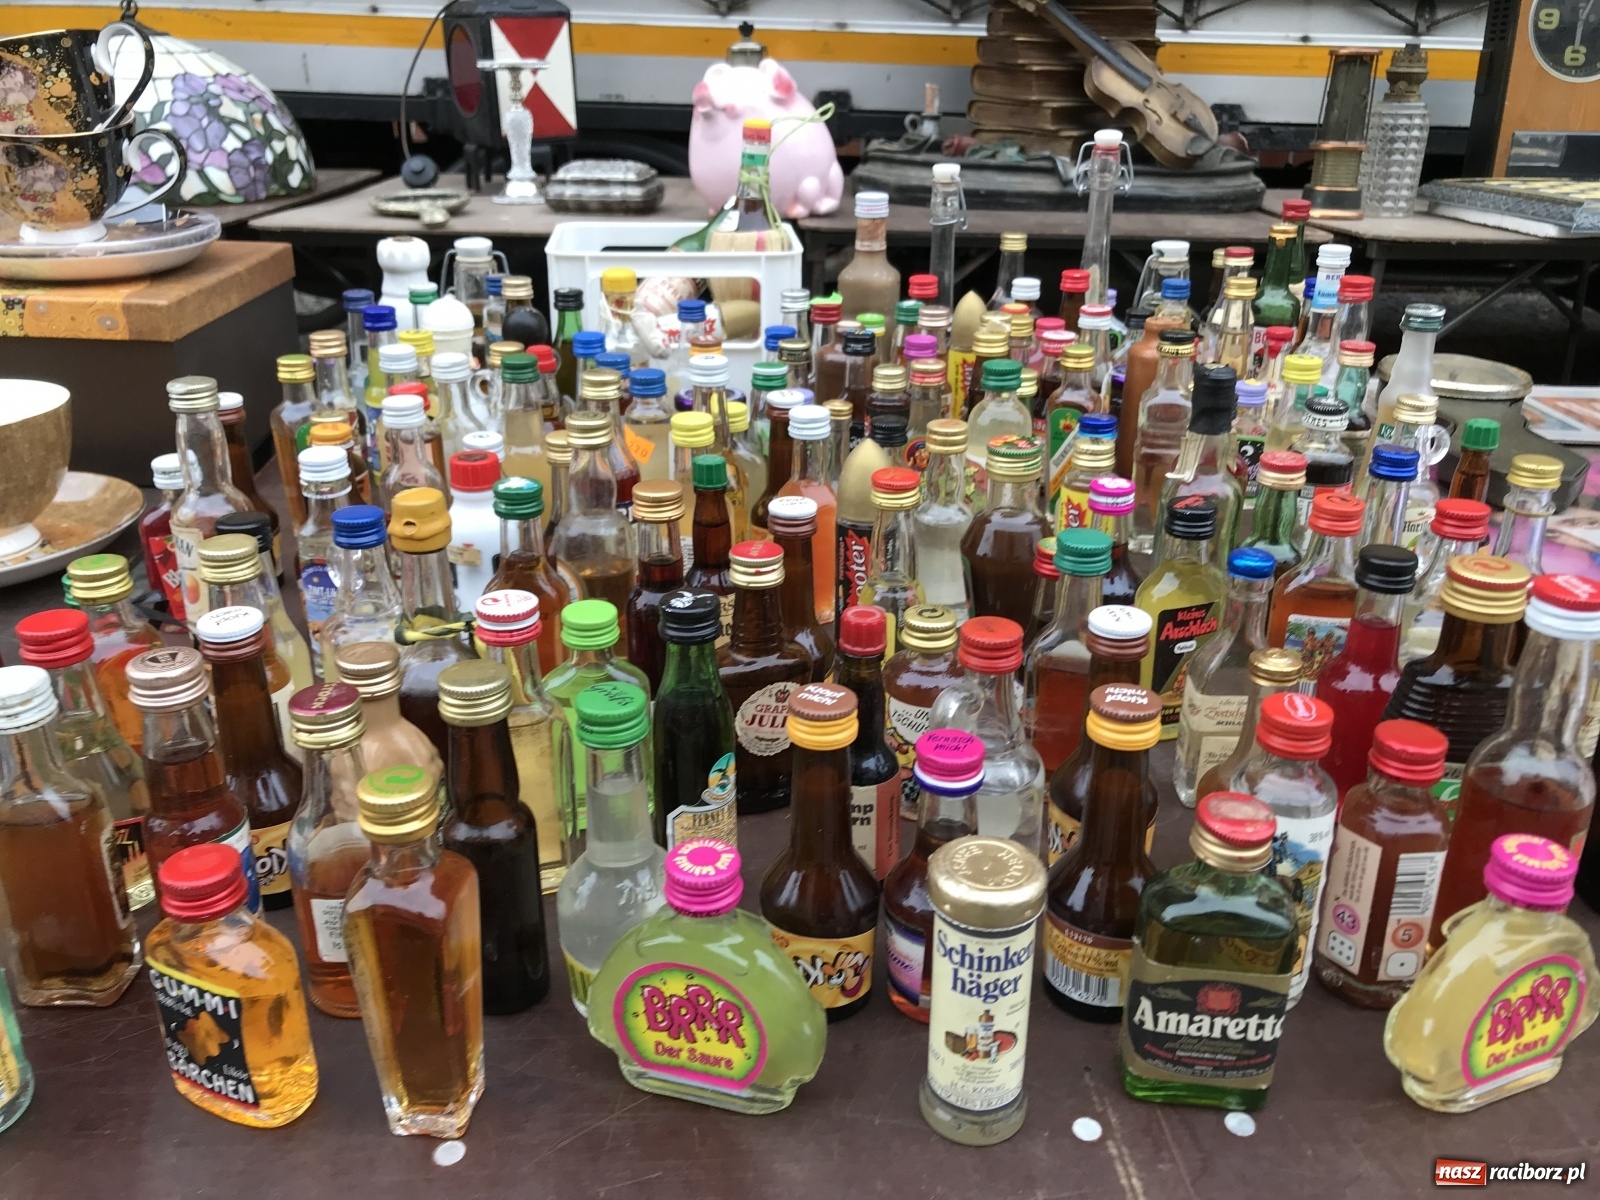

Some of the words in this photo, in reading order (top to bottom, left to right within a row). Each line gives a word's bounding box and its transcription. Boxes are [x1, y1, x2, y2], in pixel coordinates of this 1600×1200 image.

[1538, 8, 1560, 30] 9
[1564, 45, 1587, 66] 6
[310, 683, 338, 709] STOCK
[797, 692, 838, 705] mich!
[804, 685, 846, 698] Klopf
[1105, 694, 1148, 705] Klopf
[927, 733, 974, 744] Vernasch
[934, 744, 967, 752] mich!
[1401, 928, 1413, 942] 5
[951, 967, 1023, 1004] häger
[641, 984, 745, 1049] BRRR
[1486, 974, 1572, 1048] BRRR
[654, 1040, 682, 1060] Der
[687, 1046, 734, 1071] Saure
[1486, 1049, 1510, 1069] Der
[1511, 1035, 1549, 1058] Saure
